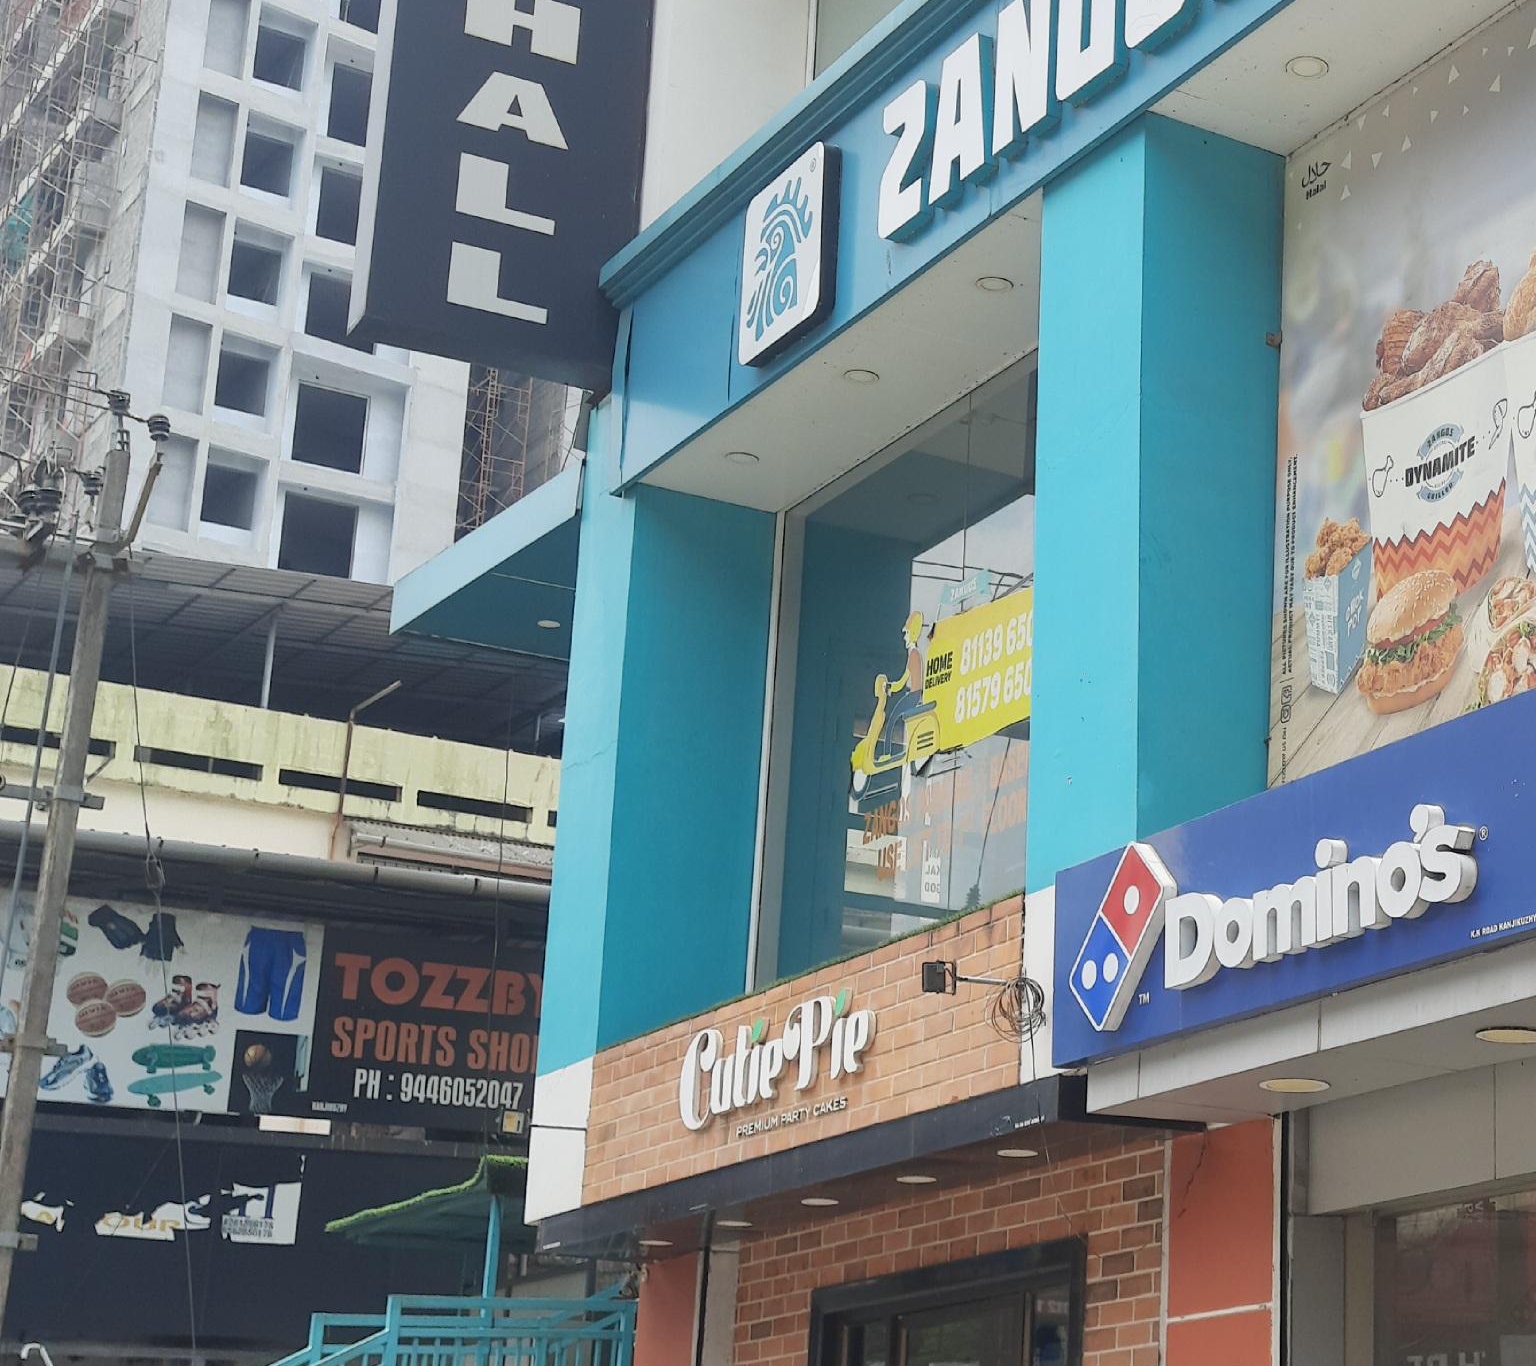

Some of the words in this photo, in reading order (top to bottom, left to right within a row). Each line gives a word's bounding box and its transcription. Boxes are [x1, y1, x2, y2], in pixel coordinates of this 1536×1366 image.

[1305, 179, 1327, 201] Halal
[1405, 435, 1476, 488] DYNAMITE
[926, 651, 953, 677] HOME
[960, 623, 1004, 676] 81139
[924, 671, 952, 690] DELIVERY
[955, 672, 1002, 724] 81579
[1164, 803, 1479, 990] Domino's
[1482, 924, 1498, 936] ROAD
[331, 1015, 457, 1067] SPORTS
[467, 1029, 537, 1074] SHO
[353, 1067, 382, 1100] PH
[400, 1072, 524, 1110] 9446052047
[735, 1115, 778, 1137] PREMIUM
[780, 1106, 811, 1126] PARTY
[813, 1096, 848, 1116] CAKES
